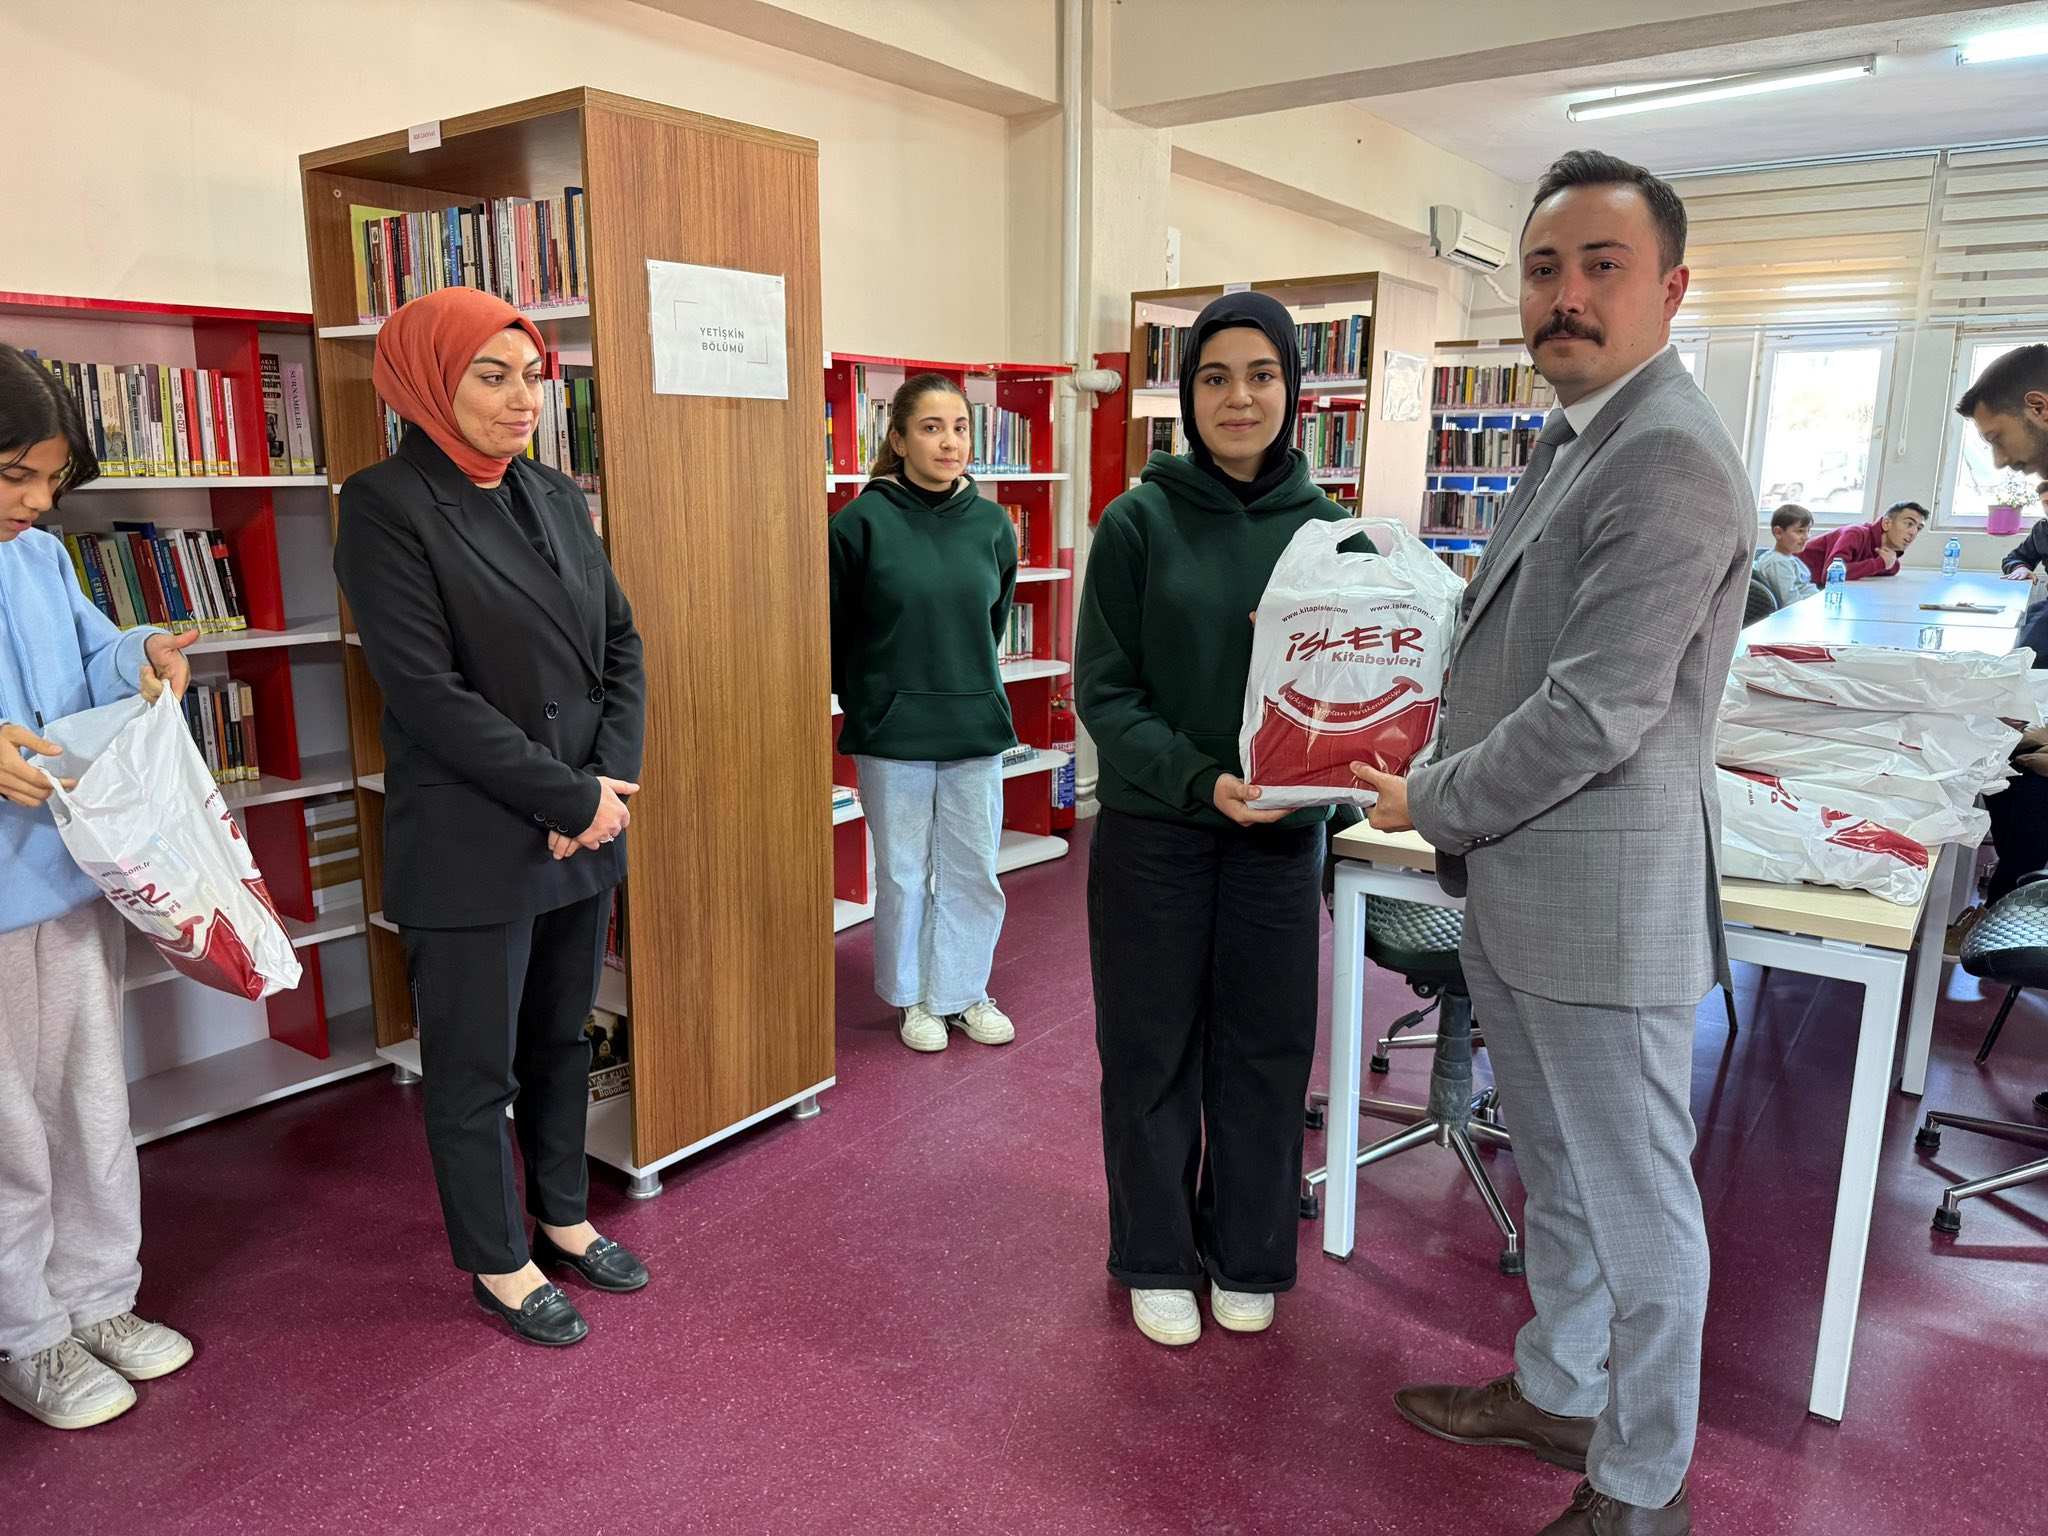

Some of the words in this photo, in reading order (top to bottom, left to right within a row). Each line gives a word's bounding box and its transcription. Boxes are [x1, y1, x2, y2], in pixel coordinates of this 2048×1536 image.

[700, 326, 745, 340] YETİŞKİN
[701, 341, 745, 354] BÖLÜMÜ
[290, 370, 303, 429] SURNAMELER
[1331, 651, 1422, 668] Kitabevleri
